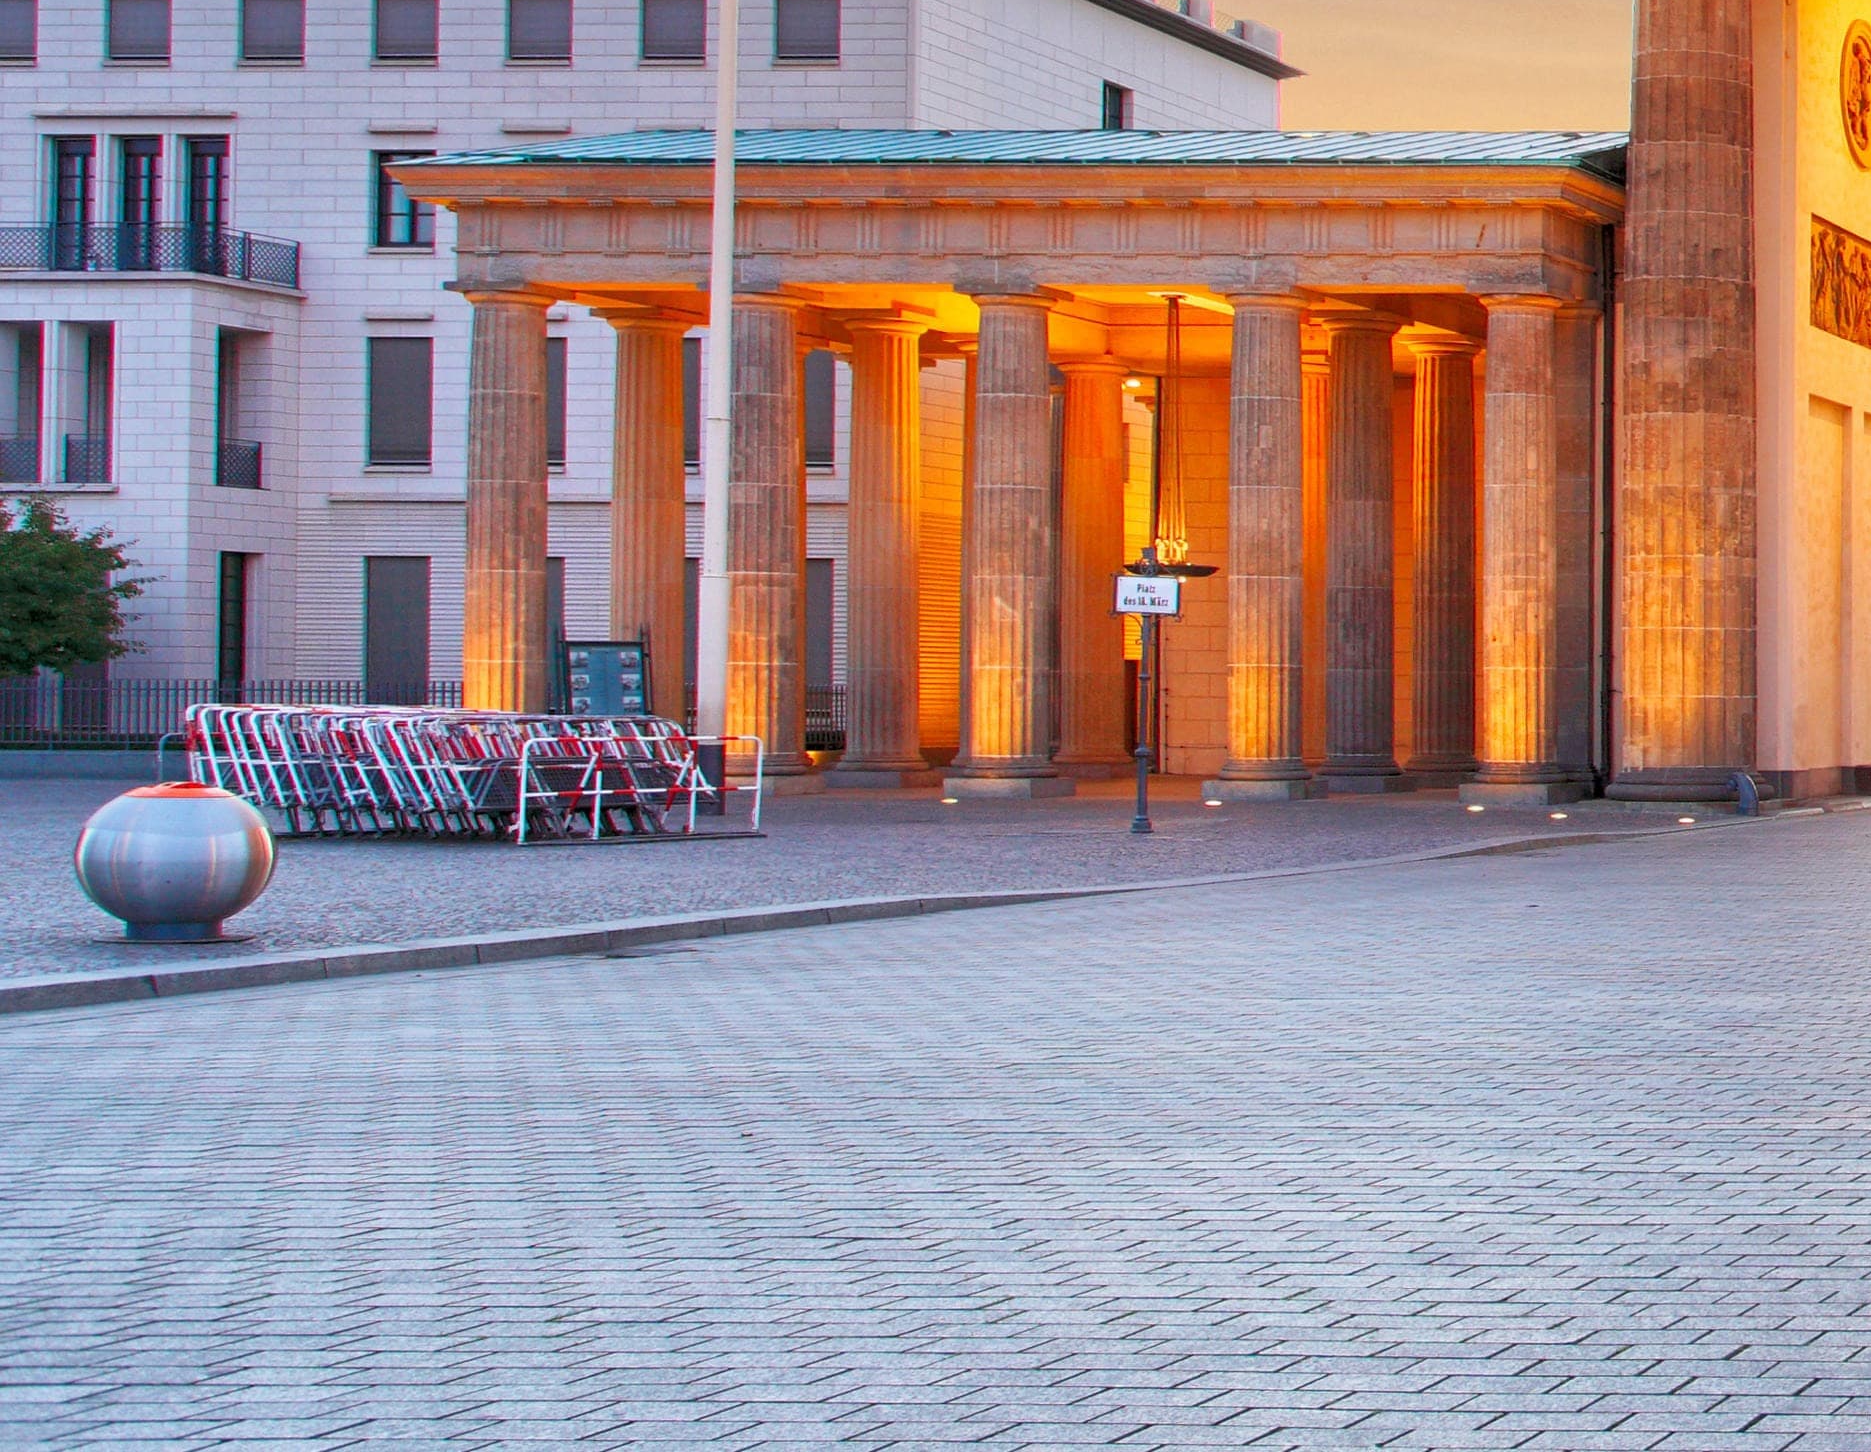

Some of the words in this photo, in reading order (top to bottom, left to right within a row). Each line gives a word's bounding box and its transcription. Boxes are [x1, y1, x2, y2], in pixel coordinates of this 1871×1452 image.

[1137, 583, 1156, 593] Platz
[1124, 596, 1136, 605] des
[1138, 596, 1148, 606] 18.
[1150, 596, 1169, 606] März
